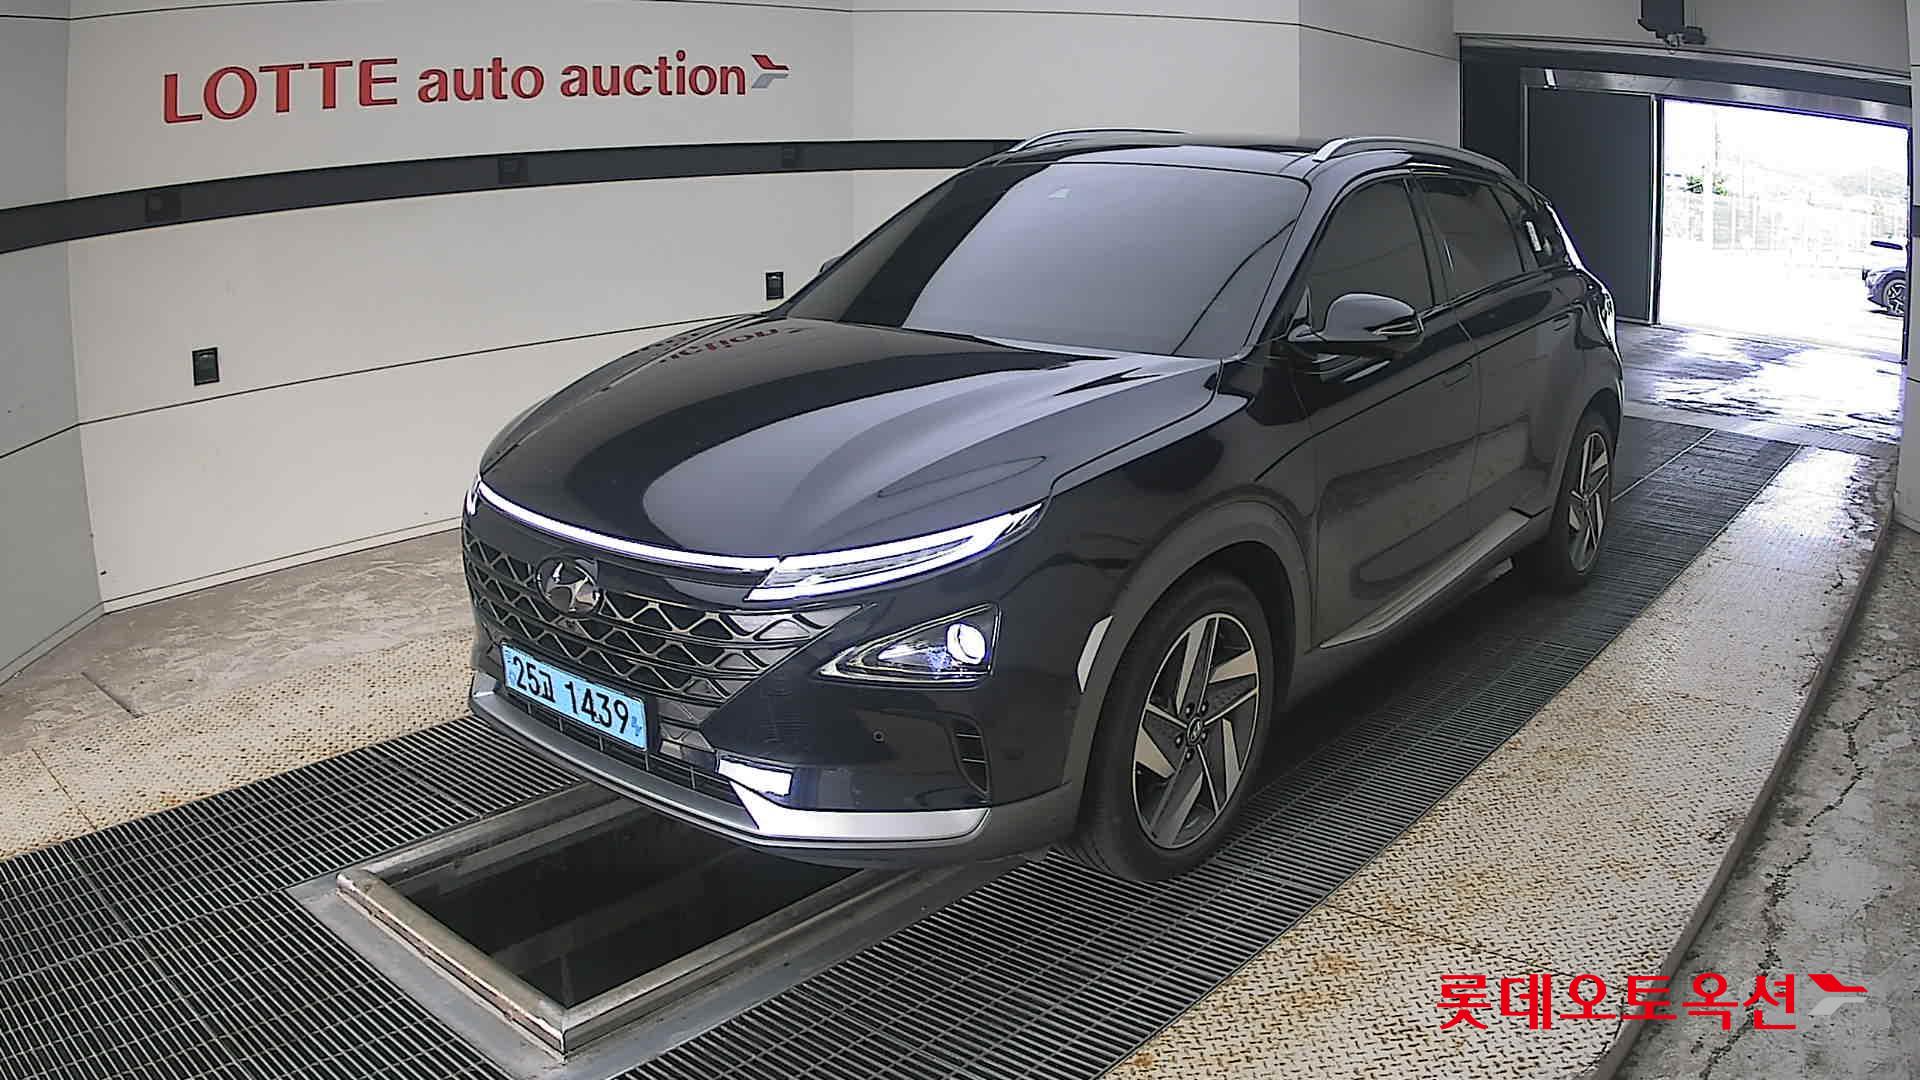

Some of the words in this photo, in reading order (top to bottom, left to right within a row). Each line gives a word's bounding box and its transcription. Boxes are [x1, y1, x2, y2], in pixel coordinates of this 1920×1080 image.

[163, 57, 397, 125] LOTTE
[418, 57, 545, 103] auto
[560, 50, 746, 97] auction
[513, 656, 556, 703] 25고
[564, 680, 629, 734] 1439
